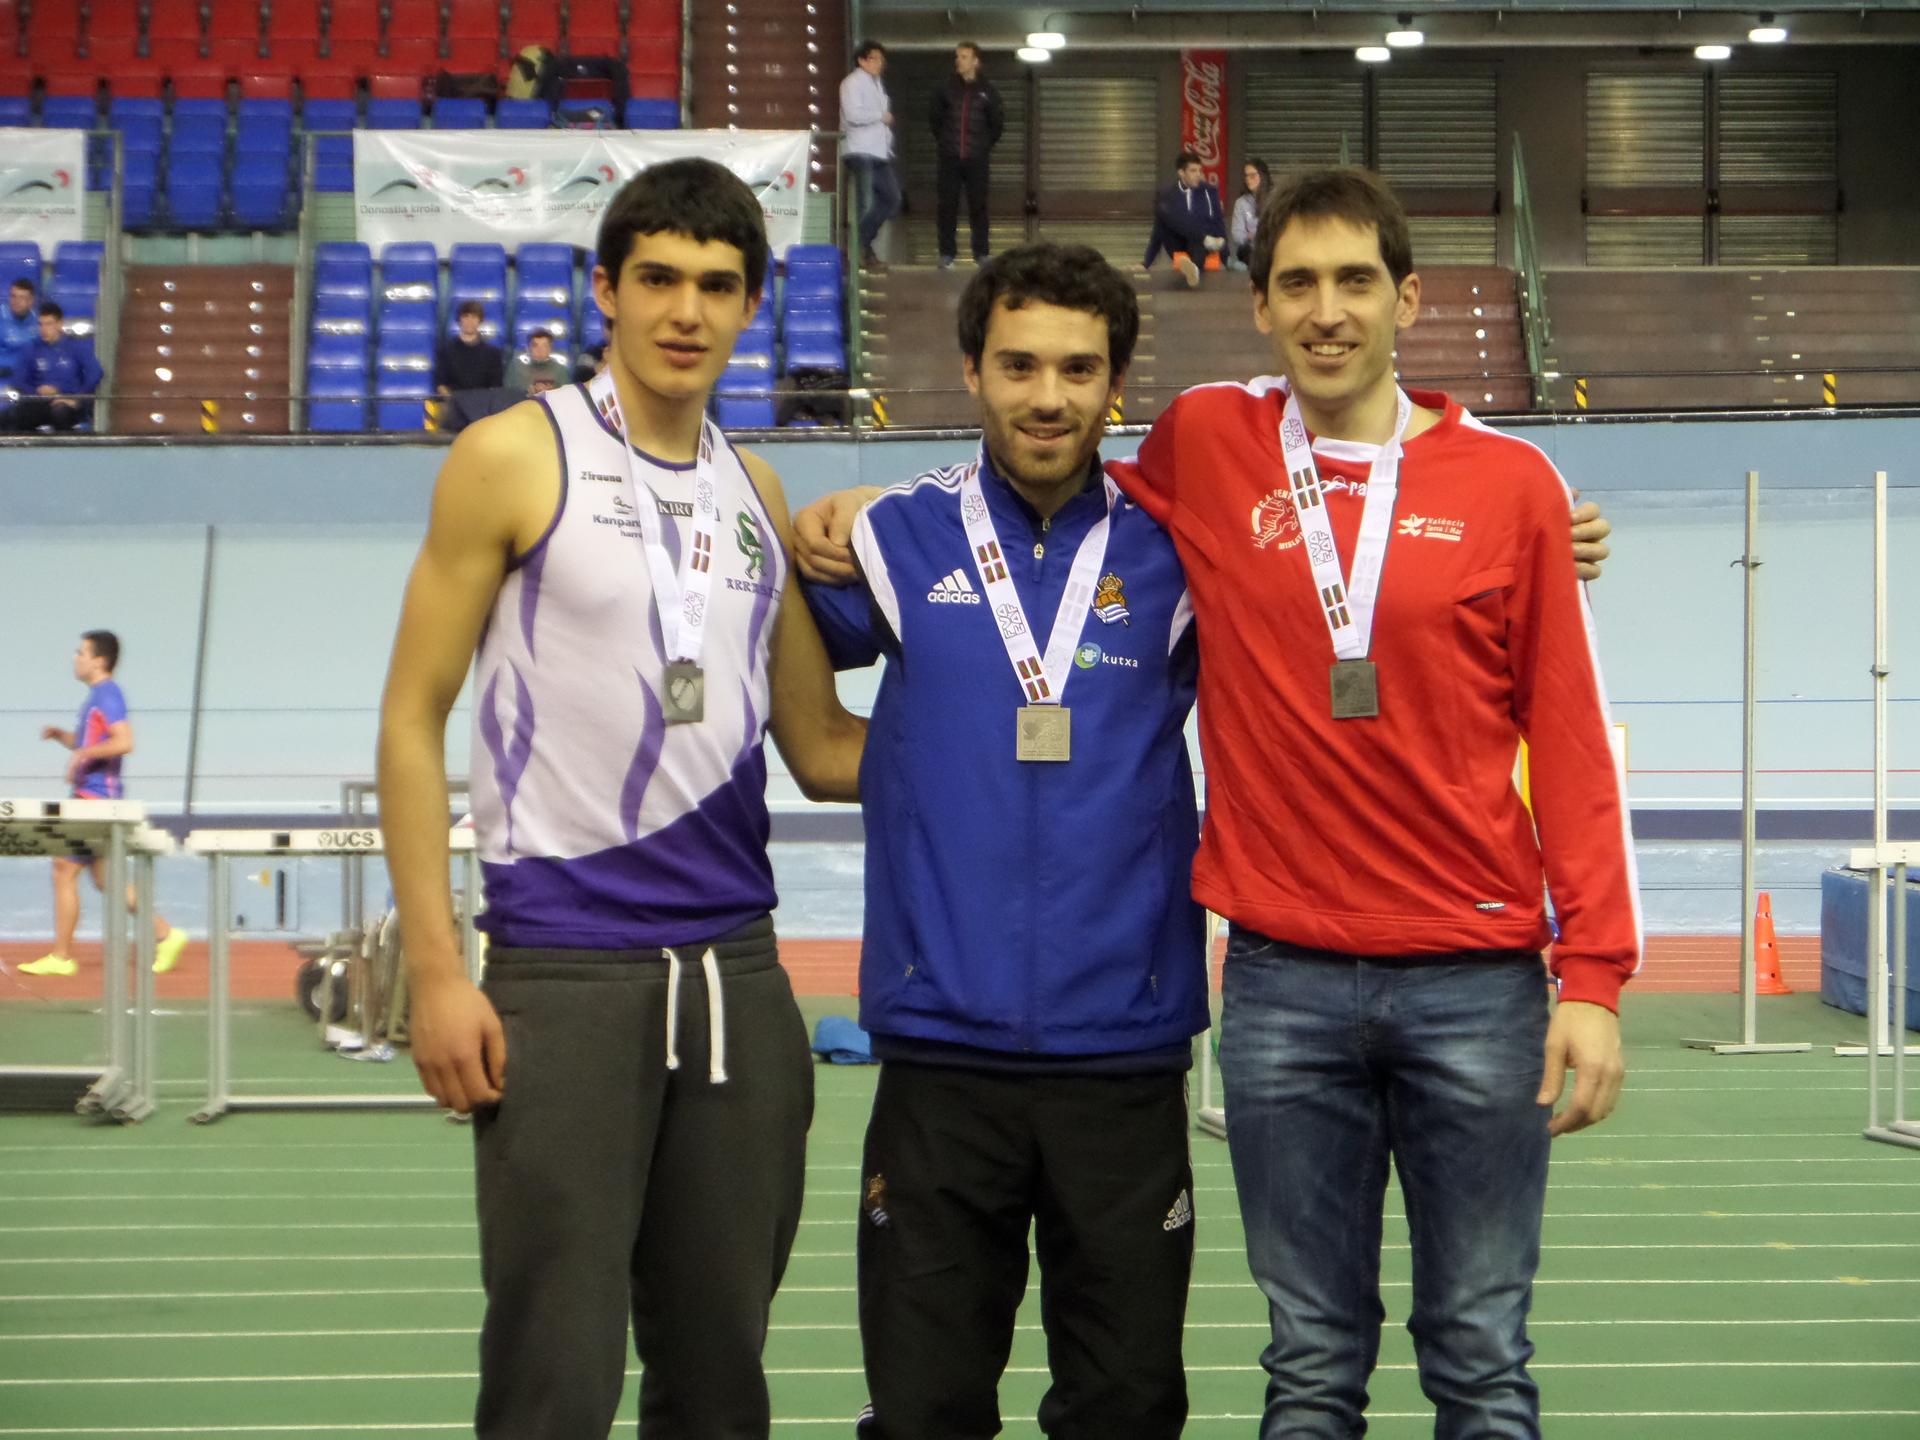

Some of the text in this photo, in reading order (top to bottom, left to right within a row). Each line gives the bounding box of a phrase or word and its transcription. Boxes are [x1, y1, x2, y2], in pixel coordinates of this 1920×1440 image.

[411, 203, 440, 214] kirola
[771, 206, 798, 217] kirola
[927, 589, 980, 605] adidas
[1102, 652, 1138, 668] kutxa
[333, 831, 375, 847] UCS
